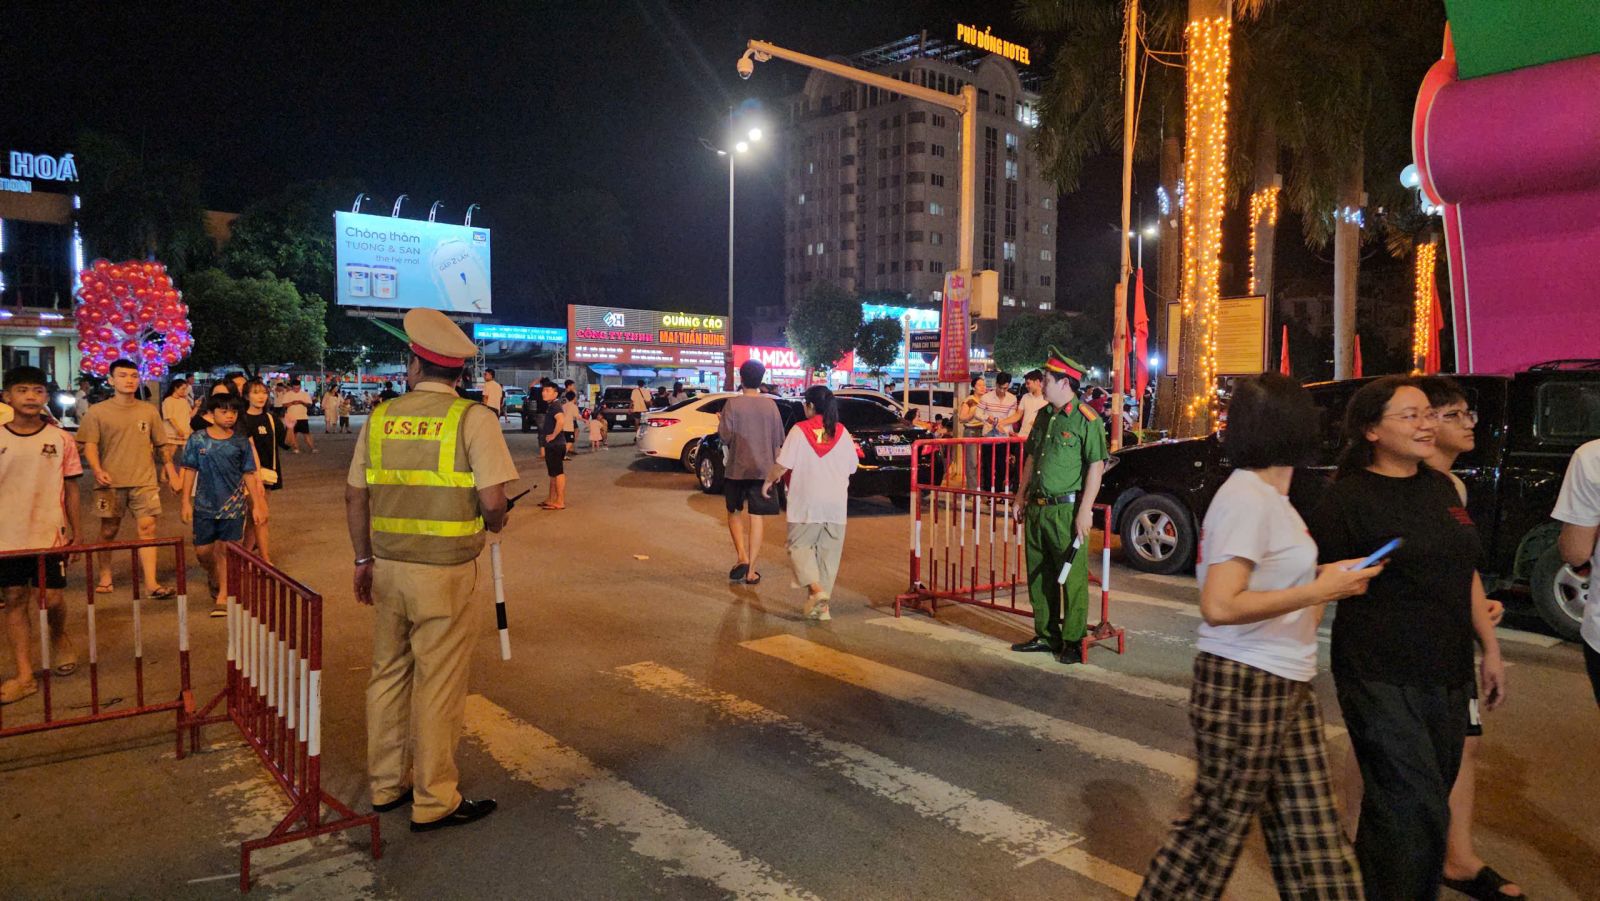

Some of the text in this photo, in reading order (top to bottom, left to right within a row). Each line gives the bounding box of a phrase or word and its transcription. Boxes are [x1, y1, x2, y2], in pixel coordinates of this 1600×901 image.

[1003, 40, 1030, 65] HOTEL
[662, 312, 723, 329] QUẢNG CÁO
[576, 327, 607, 339] CÔNG
[609, 331, 623, 340] TY
[660, 330, 678, 343] MAI
[679, 328, 702, 344] TUẤN
[762, 350, 801, 367] MIXU
